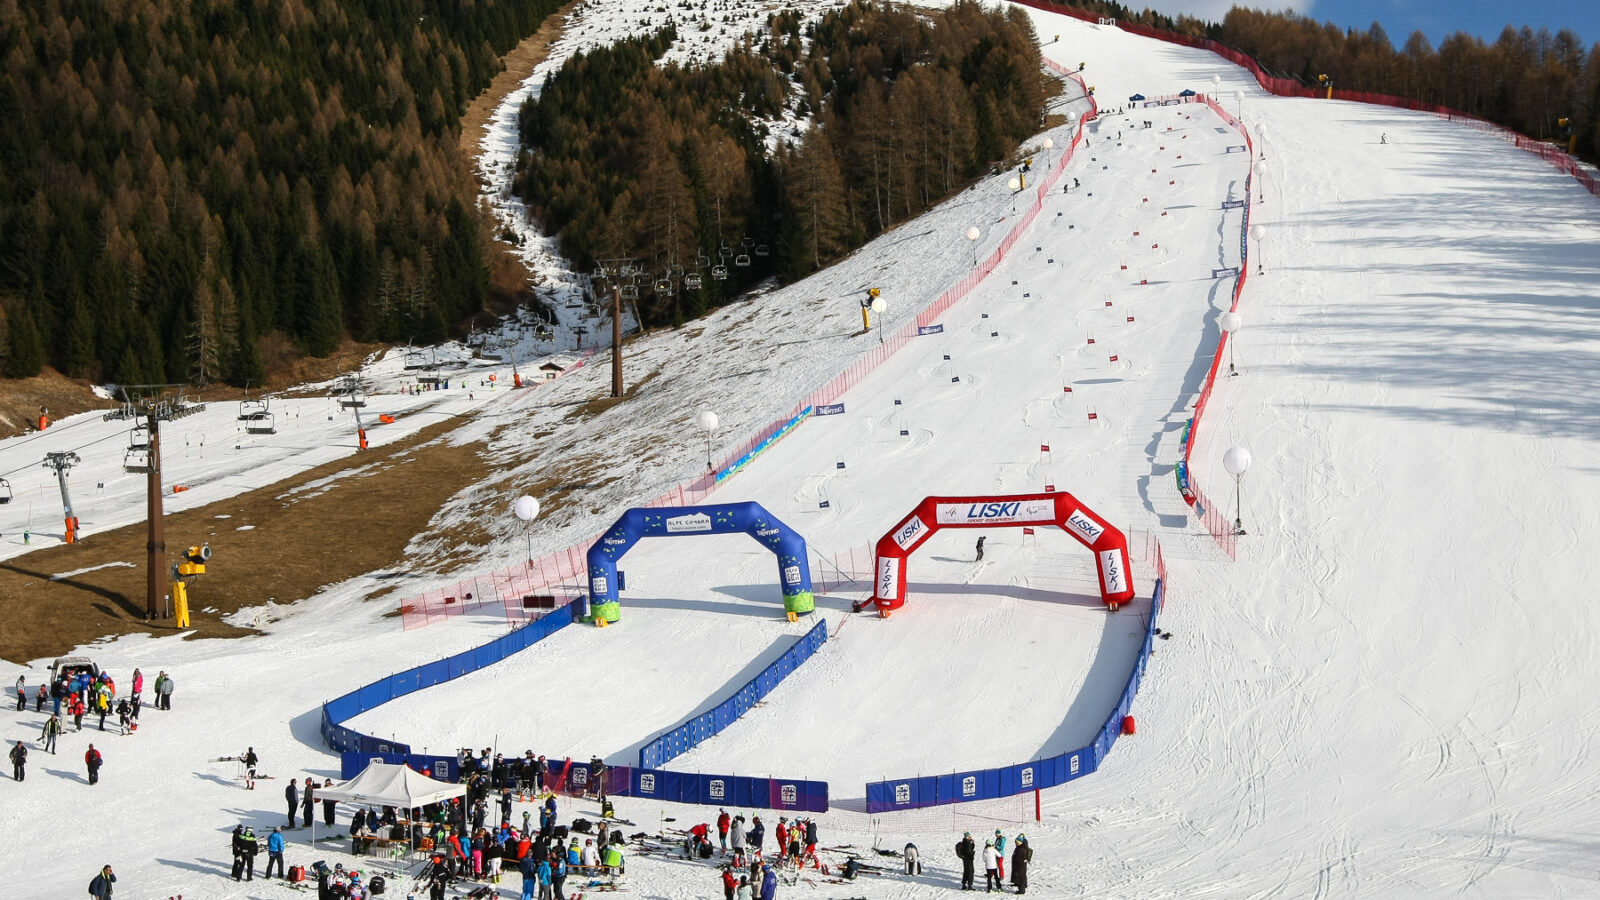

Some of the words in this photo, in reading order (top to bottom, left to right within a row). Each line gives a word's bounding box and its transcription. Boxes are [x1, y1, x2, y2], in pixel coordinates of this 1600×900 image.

[967, 502, 1021, 518] LISKI
[897, 518, 921, 545] LISKI
[1070, 515, 1101, 537] LISKI
[882, 559, 892, 597] LISKI
[1108, 552, 1119, 591] LISKI
